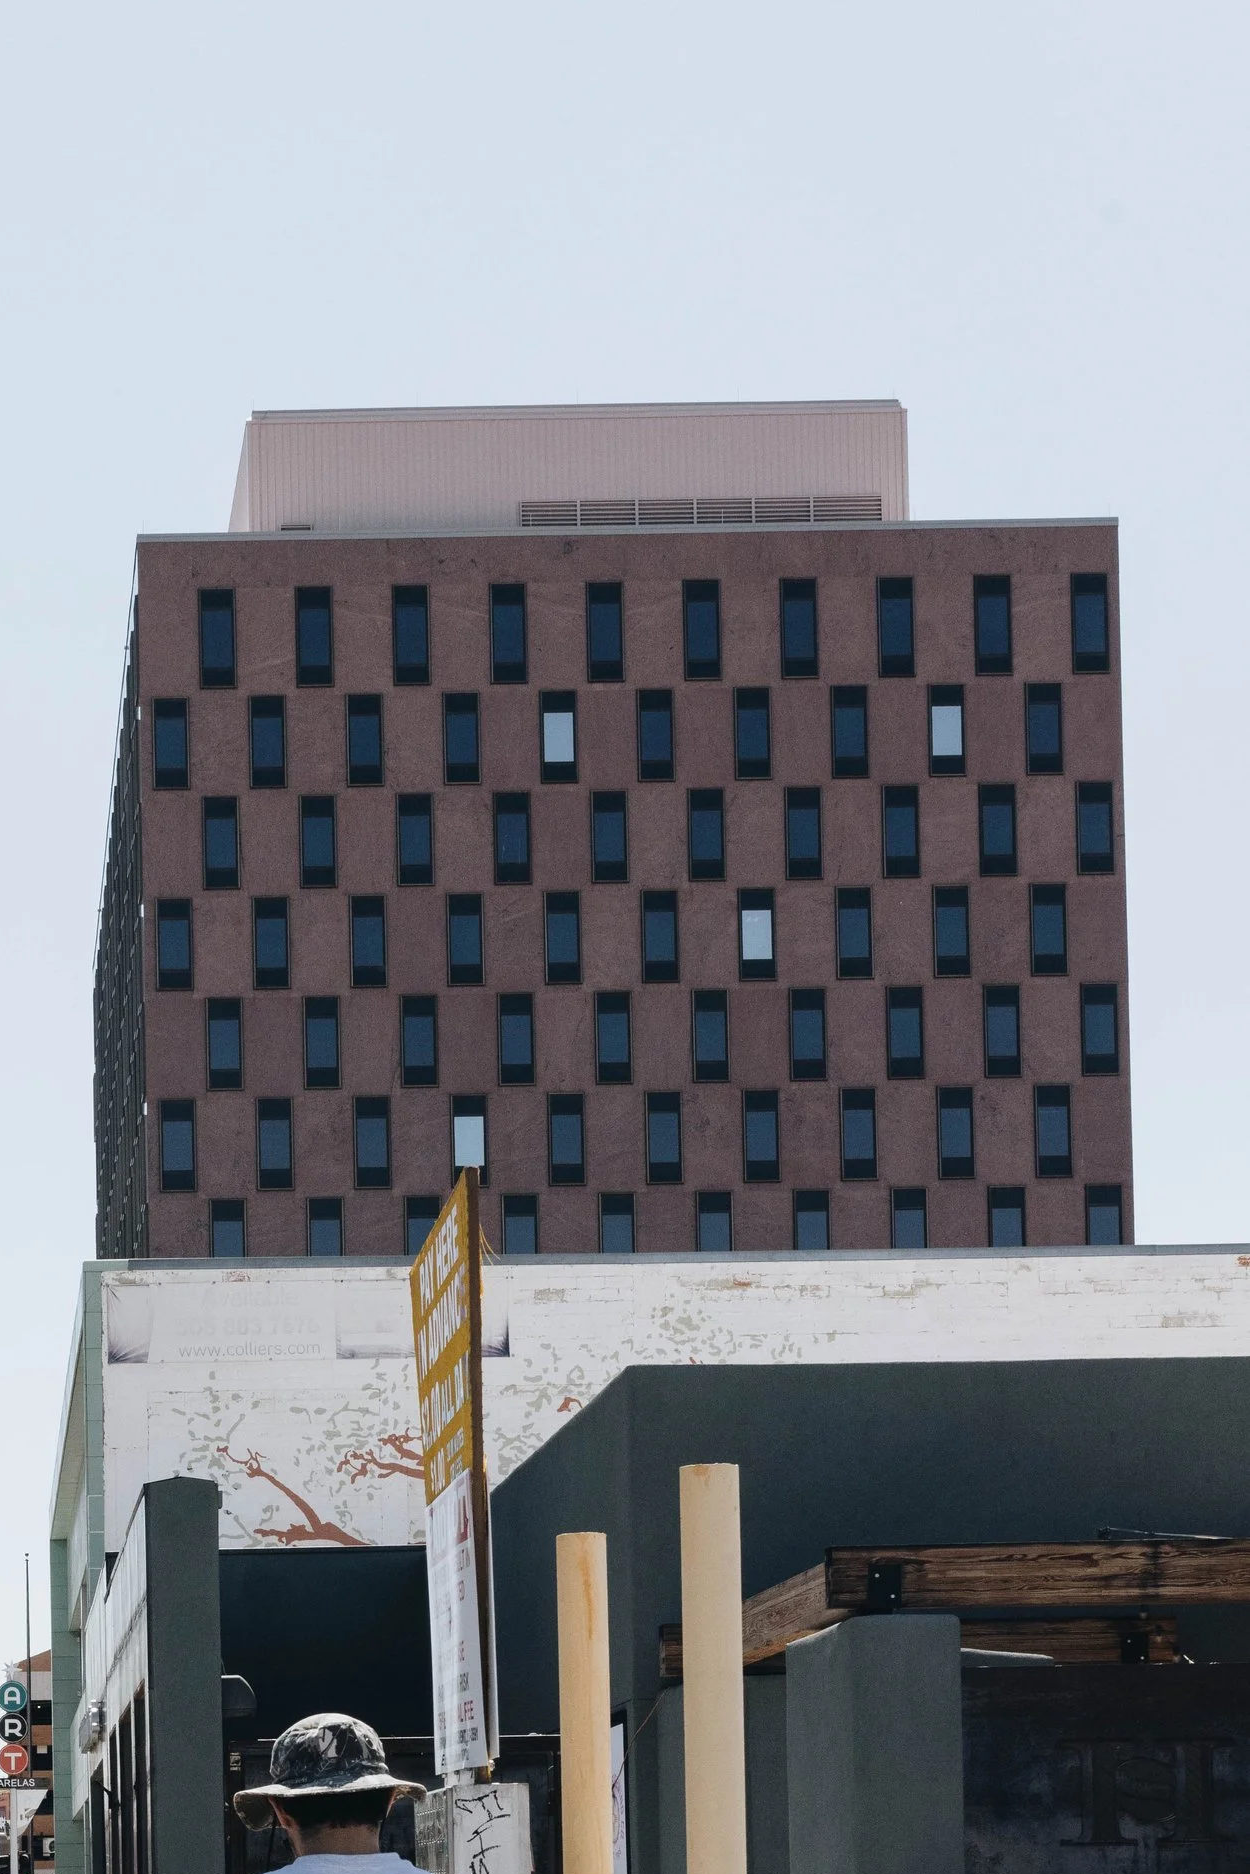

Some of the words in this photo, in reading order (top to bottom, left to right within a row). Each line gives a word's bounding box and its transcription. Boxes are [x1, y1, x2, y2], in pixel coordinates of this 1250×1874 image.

[419, 1245, 434, 1317] PAY
[435, 1203, 459, 1291] HERE
[177, 1341, 322, 1358] www.colliers.com
[417, 1324, 428, 1384] IN
[441, 1374, 455, 1431] ALL
